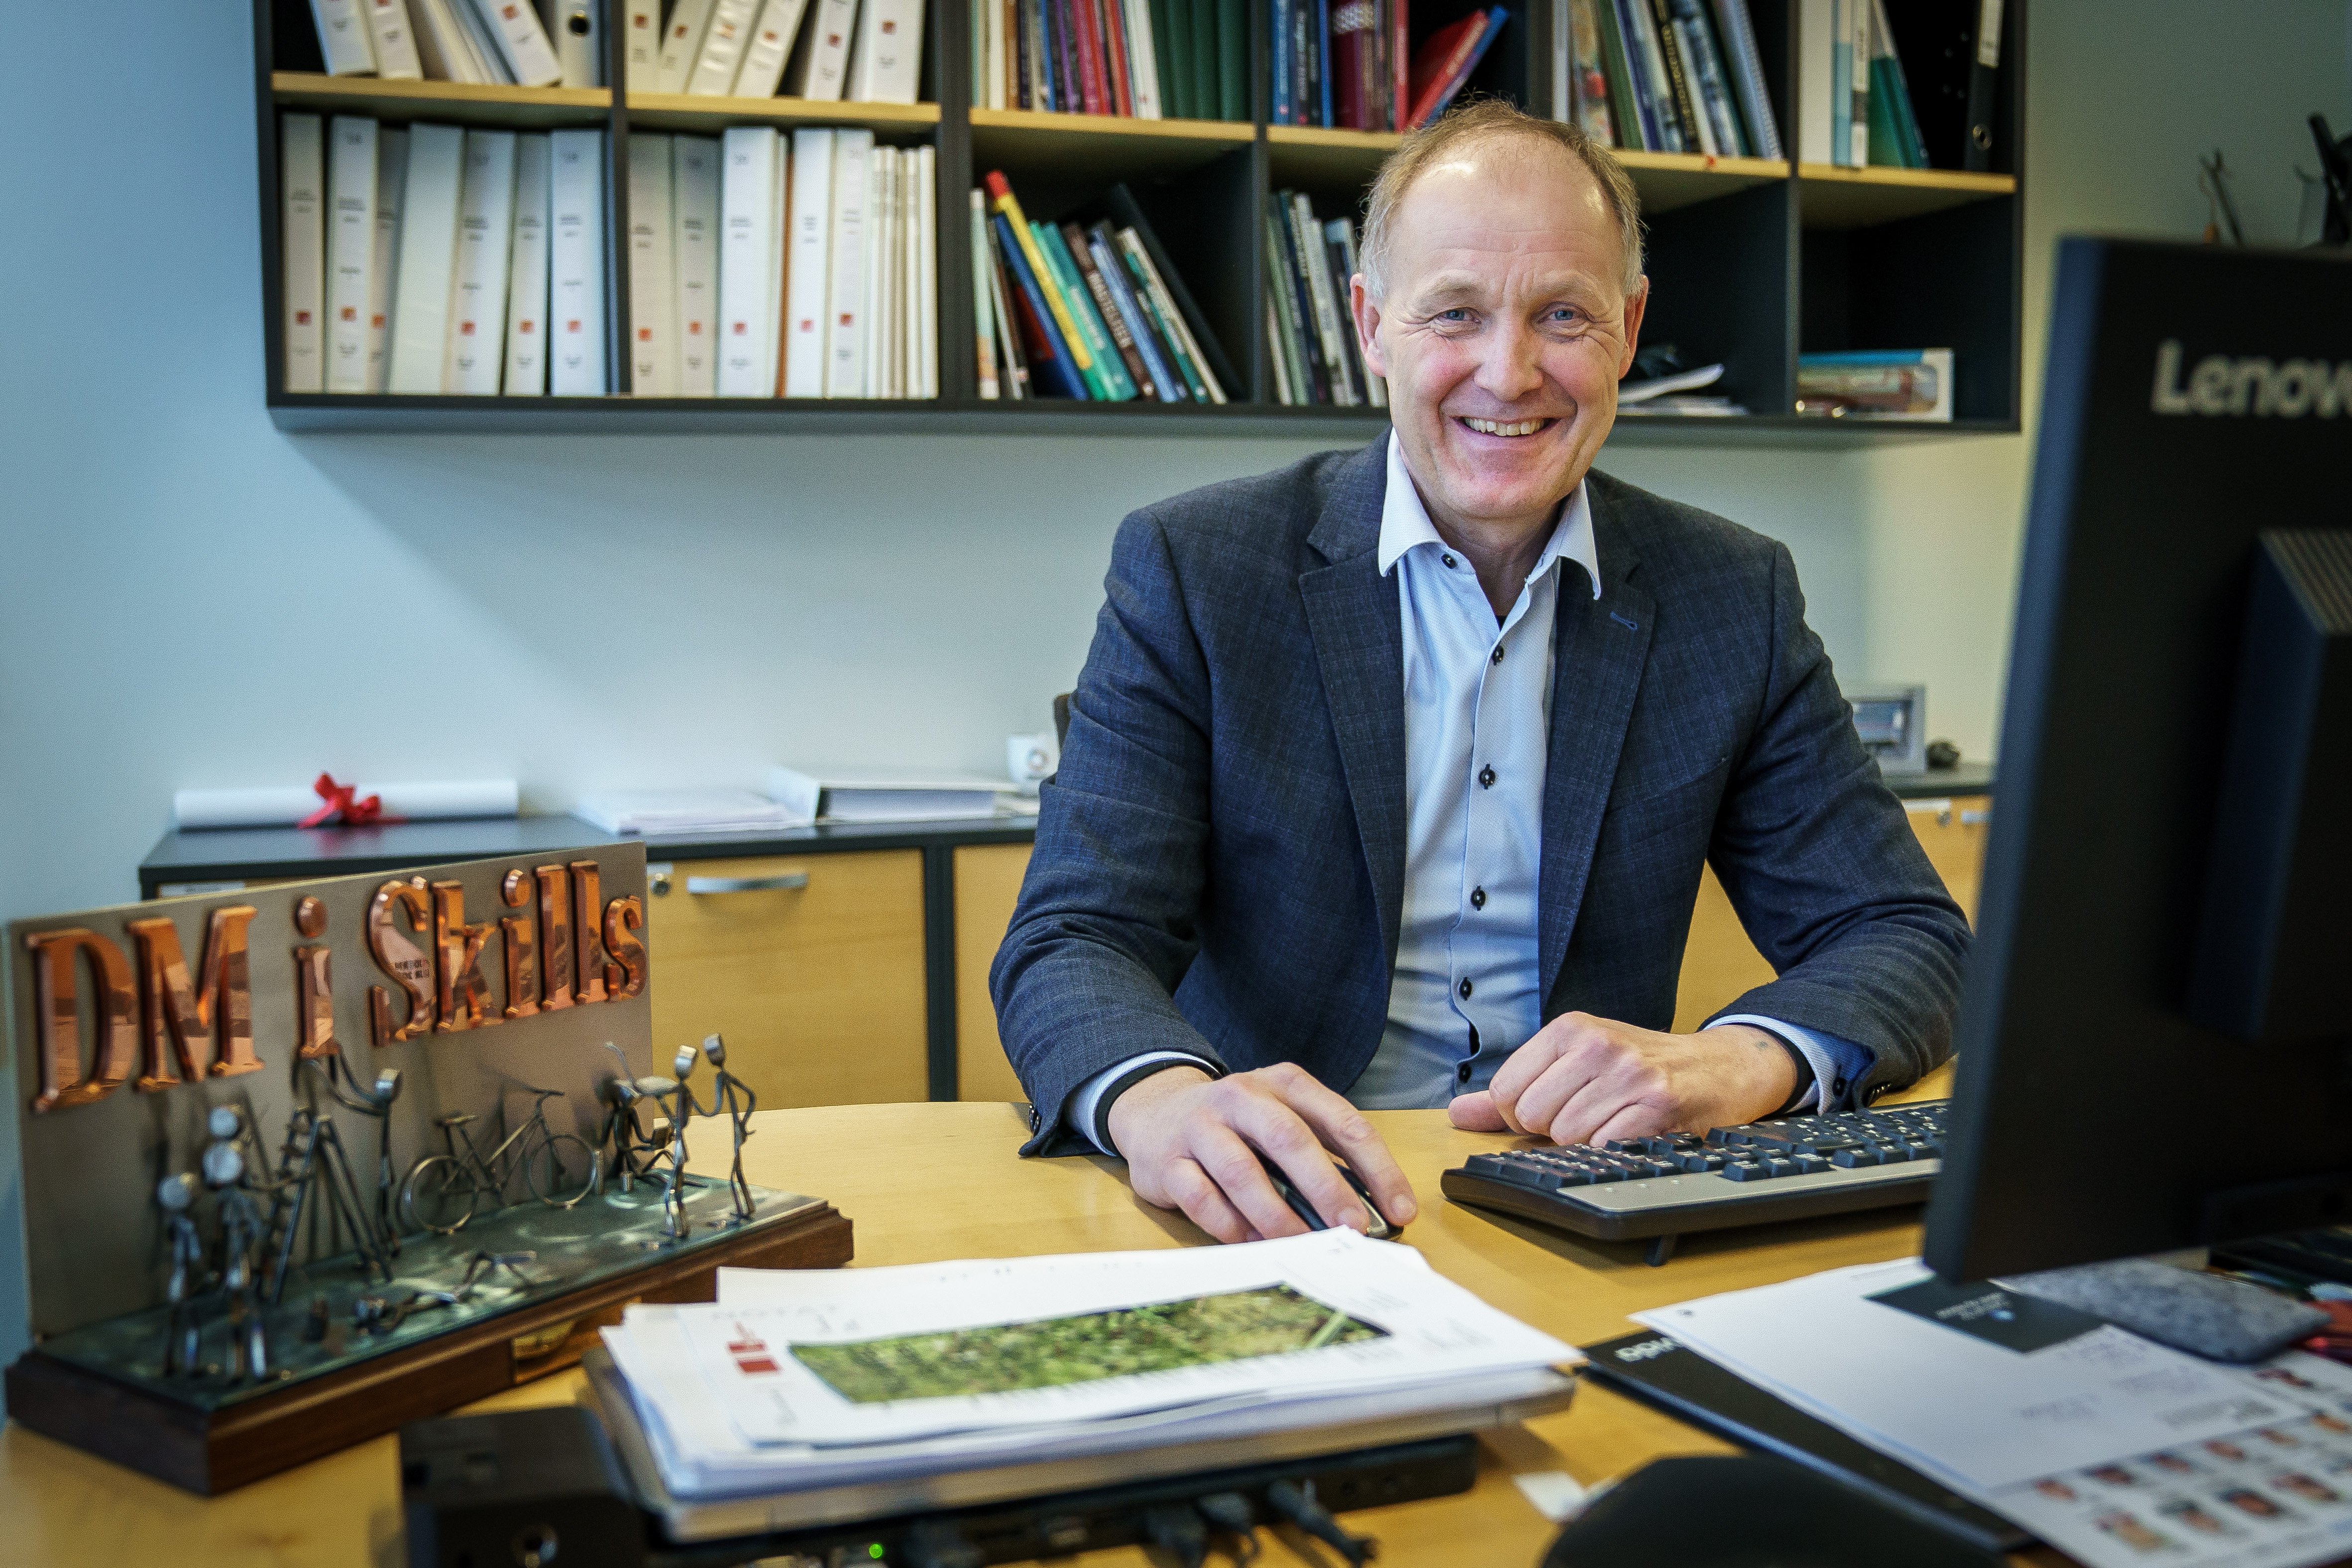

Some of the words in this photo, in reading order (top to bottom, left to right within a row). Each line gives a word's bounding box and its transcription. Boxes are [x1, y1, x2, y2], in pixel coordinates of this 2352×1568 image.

[2151, 337, 2352, 419] Lenov
[26, 905, 264, 1113] DM
[293, 896, 340, 1057] i
[366, 860, 648, 1047] Skills
